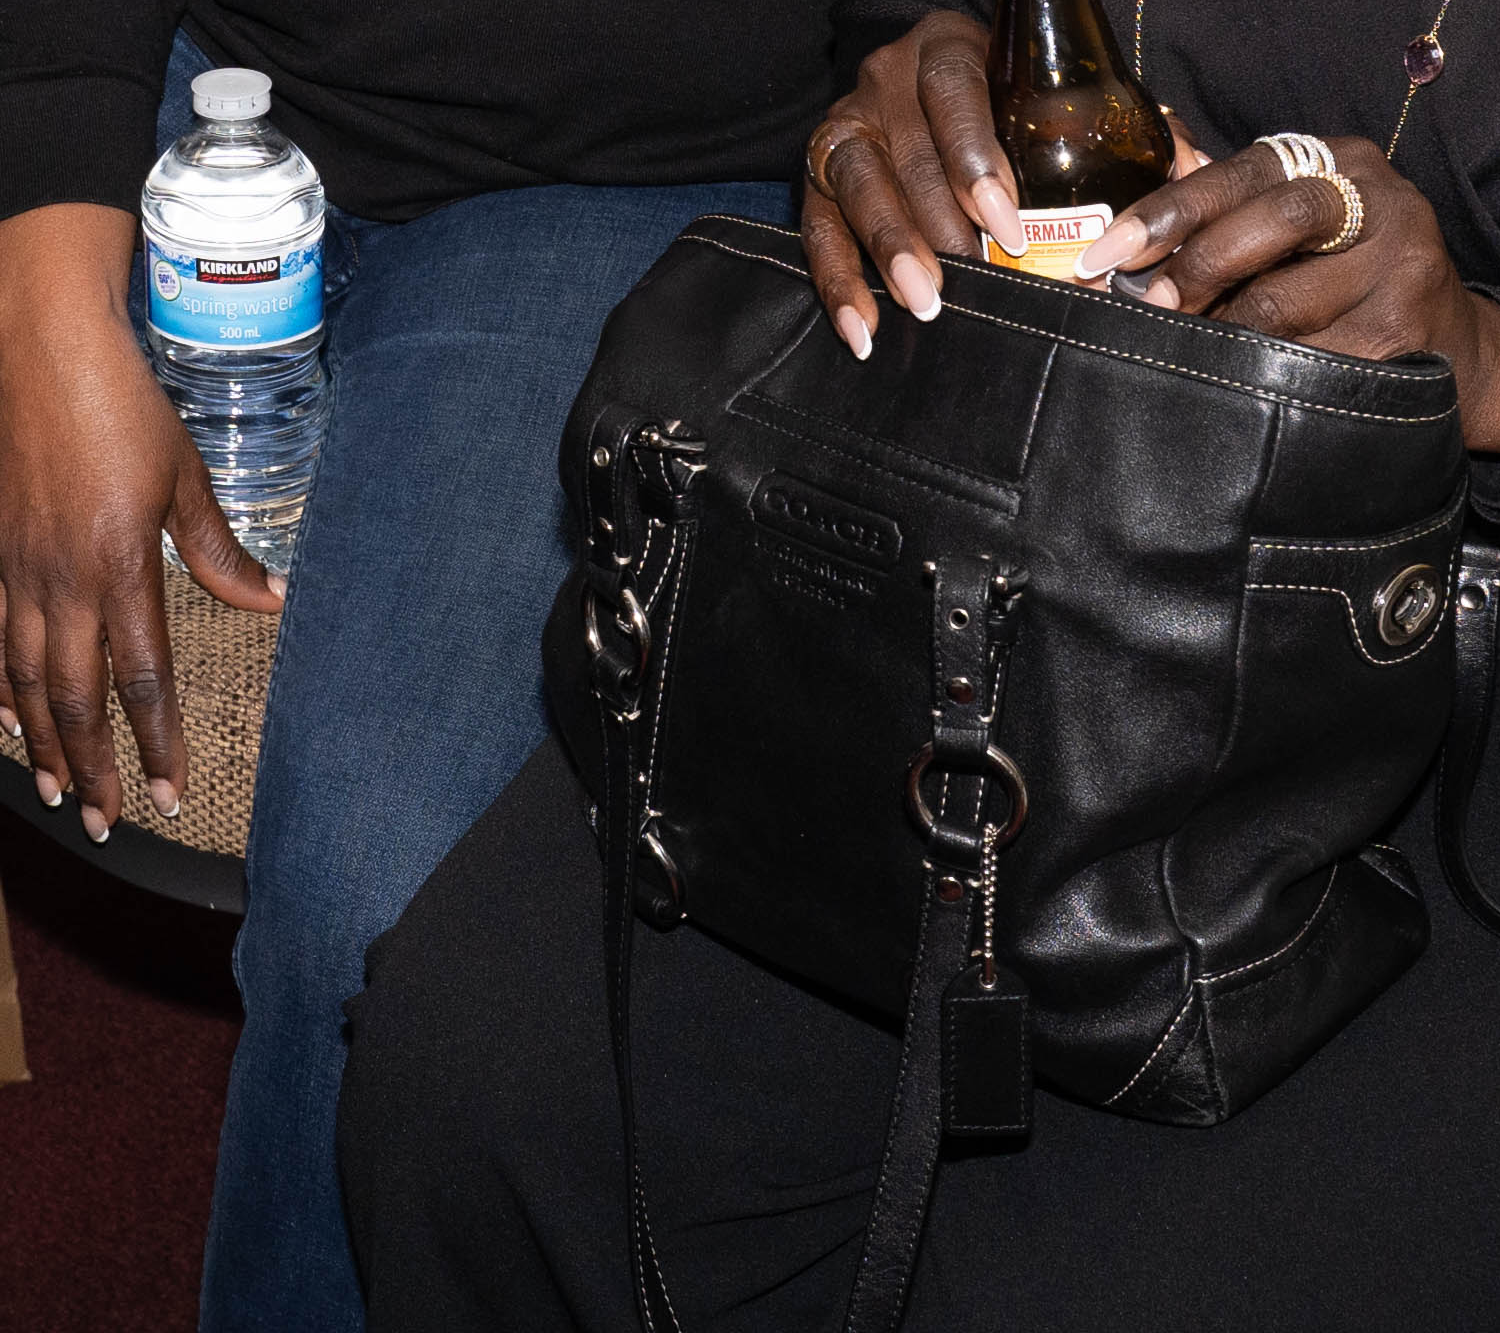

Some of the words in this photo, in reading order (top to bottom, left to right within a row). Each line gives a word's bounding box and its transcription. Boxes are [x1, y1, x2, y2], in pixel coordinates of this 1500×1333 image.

[1024, 221, 1082, 242] ERMALT
[199, 259, 278, 275] KIRKLAND
[182, 296, 239, 320] spring
[243, 295, 295, 316] water
[219, 326, 242, 339] 500
[244, 326, 261, 339] mL
[763, 489, 885, 557] COACH
